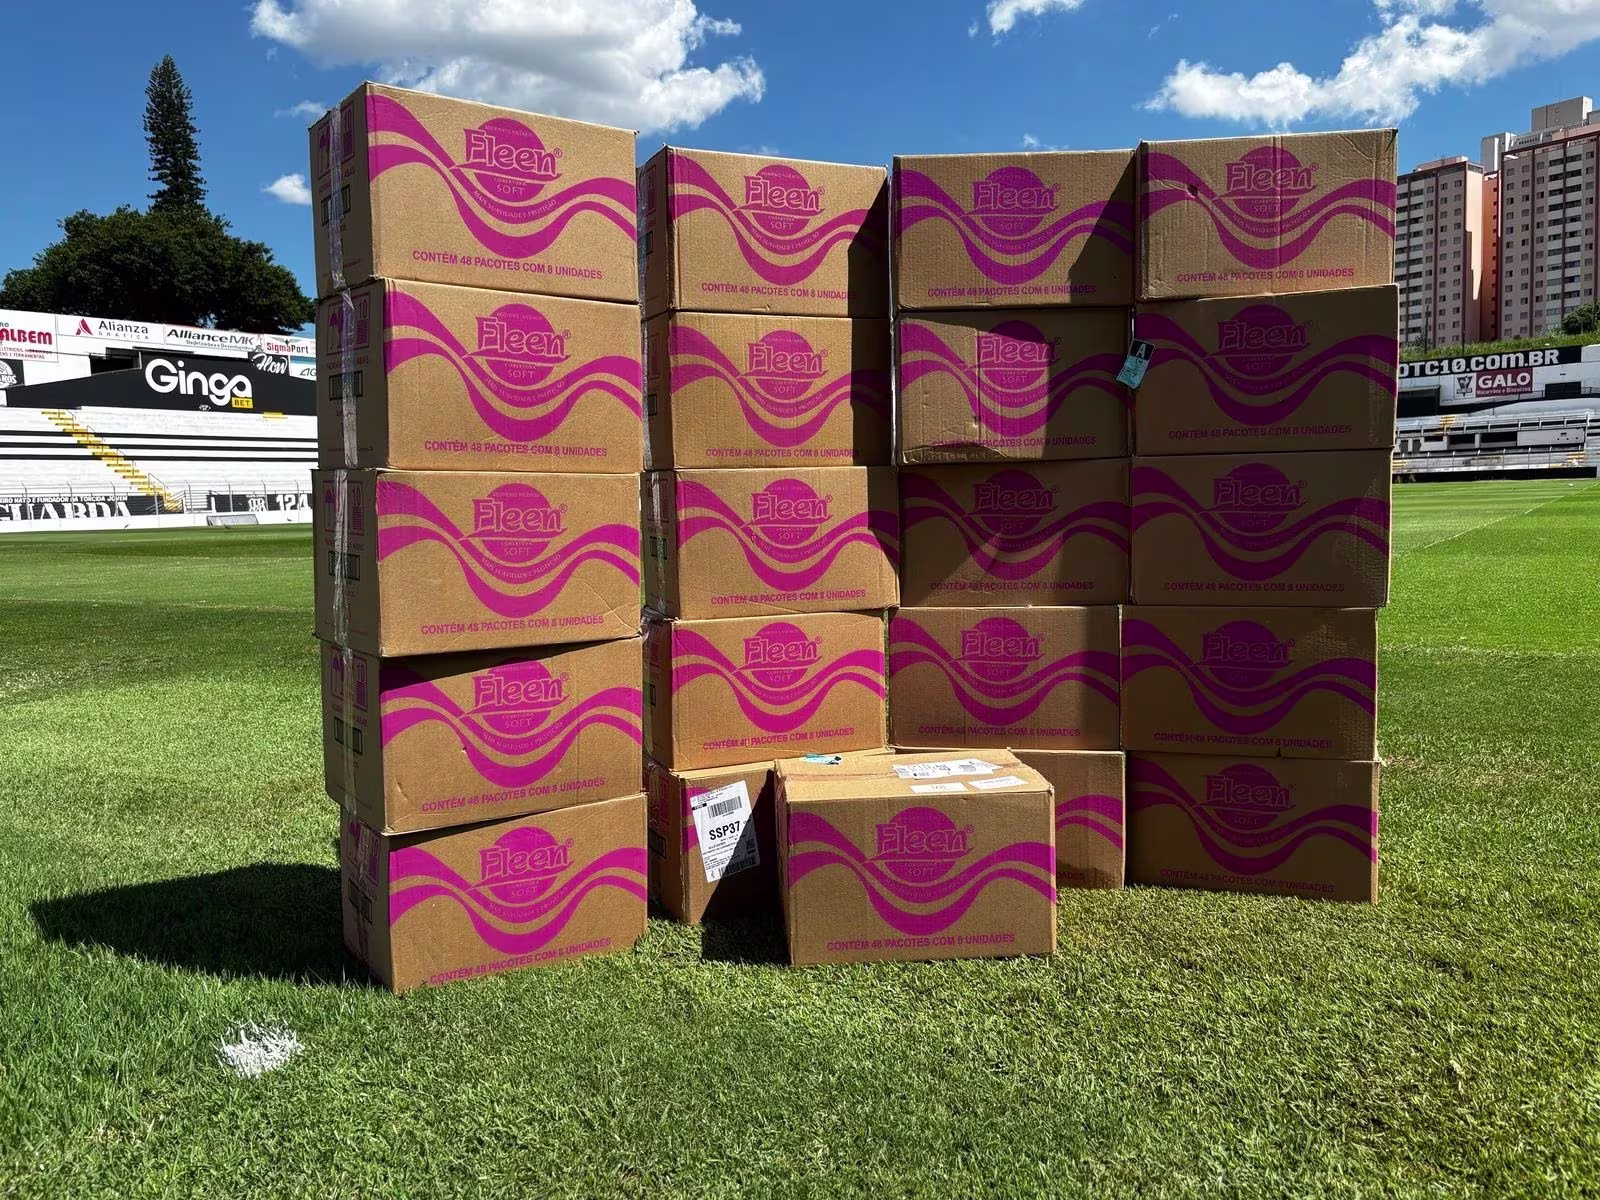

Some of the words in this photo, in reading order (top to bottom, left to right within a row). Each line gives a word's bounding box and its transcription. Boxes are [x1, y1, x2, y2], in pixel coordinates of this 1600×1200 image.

[497, 185, 525, 196] SOFT
[771, 222, 793, 230] SOFT
[412, 250, 457, 264] CONTÉM
[460, 255, 472, 266] 48
[475, 257, 520, 271] PACOTES
[522, 262, 545, 273] COM
[555, 265, 602, 279] UNIDADES
[1176, 271, 1217, 283] CONTÉM
[1217, 272, 1228, 282] 48
[1231, 270, 1272, 281] PACOTES
[1275, 270, 1297, 280] COM
[1306, 268, 1354, 278] UNIDADES
[701, 283, 738, 293] CONTÉM
[739, 285, 749, 294] 48
[751, 286, 789, 296] PACOTES
[790, 288, 808, 297] COM
[817, 289, 856, 300] UNIDADES
[928, 286, 965, 297] CONTÉM
[978, 286, 1019, 296] PACOTES
[1021, 286, 1041, 295] COM
[99, 320, 148, 334] Alianza
[267, 342, 309, 354] SigmaPort
[1135, 343, 1147, 358] A
[145, 358, 252, 406] Ginga
[508, 370, 534, 378] SOFT
[1478, 372, 1531, 388] GALO
[425, 440, 468, 451] CONTÉM
[471, 443, 482, 452] 48
[485, 443, 529, 454] PACOTES
[531, 445, 553, 455] COM
[562, 447, 607, 457] UNIDADES
[754, 449, 792, 458] PACOTES
[794, 450, 812, 458] COM
[504, 547, 530, 556] SOFT
[710, 593, 746, 605] CONTÉM
[760, 592, 797, 603] PACOTES
[800, 591, 818, 601] COM
[826, 589, 866, 600] UNIDADES
[421, 622, 465, 635] CONTÉM
[481, 619, 525, 631] PACOTES
[528, 618, 549, 629] COM
[560, 615, 604, 627] UNIDADES
[505, 719, 532, 728] SOFT
[751, 734, 788, 746] PACOTES
[789, 732, 808, 742] COM
[815, 727, 855, 739] UNIDADES
[422, 796, 465, 812] CONTÉM
[468, 795, 480, 806] 48
[482, 788, 526, 804] PACOTES
[528, 785, 550, 797] COM
[560, 778, 605, 793] UNIDADES
[709, 821, 740, 840] SSP37
[826, 938, 869, 951] CONTÉM
[871, 939, 881, 949] 48
[885, 937, 929, 948] PACOTES
[932, 936, 955, 947] COM
[965, 933, 1015, 945] UNIDADES
[475, 963, 487, 975] 48
[489, 954, 532, 972] PACOTES
[535, 949, 555, 963] COM
[566, 937, 611, 956] UNIDADES
